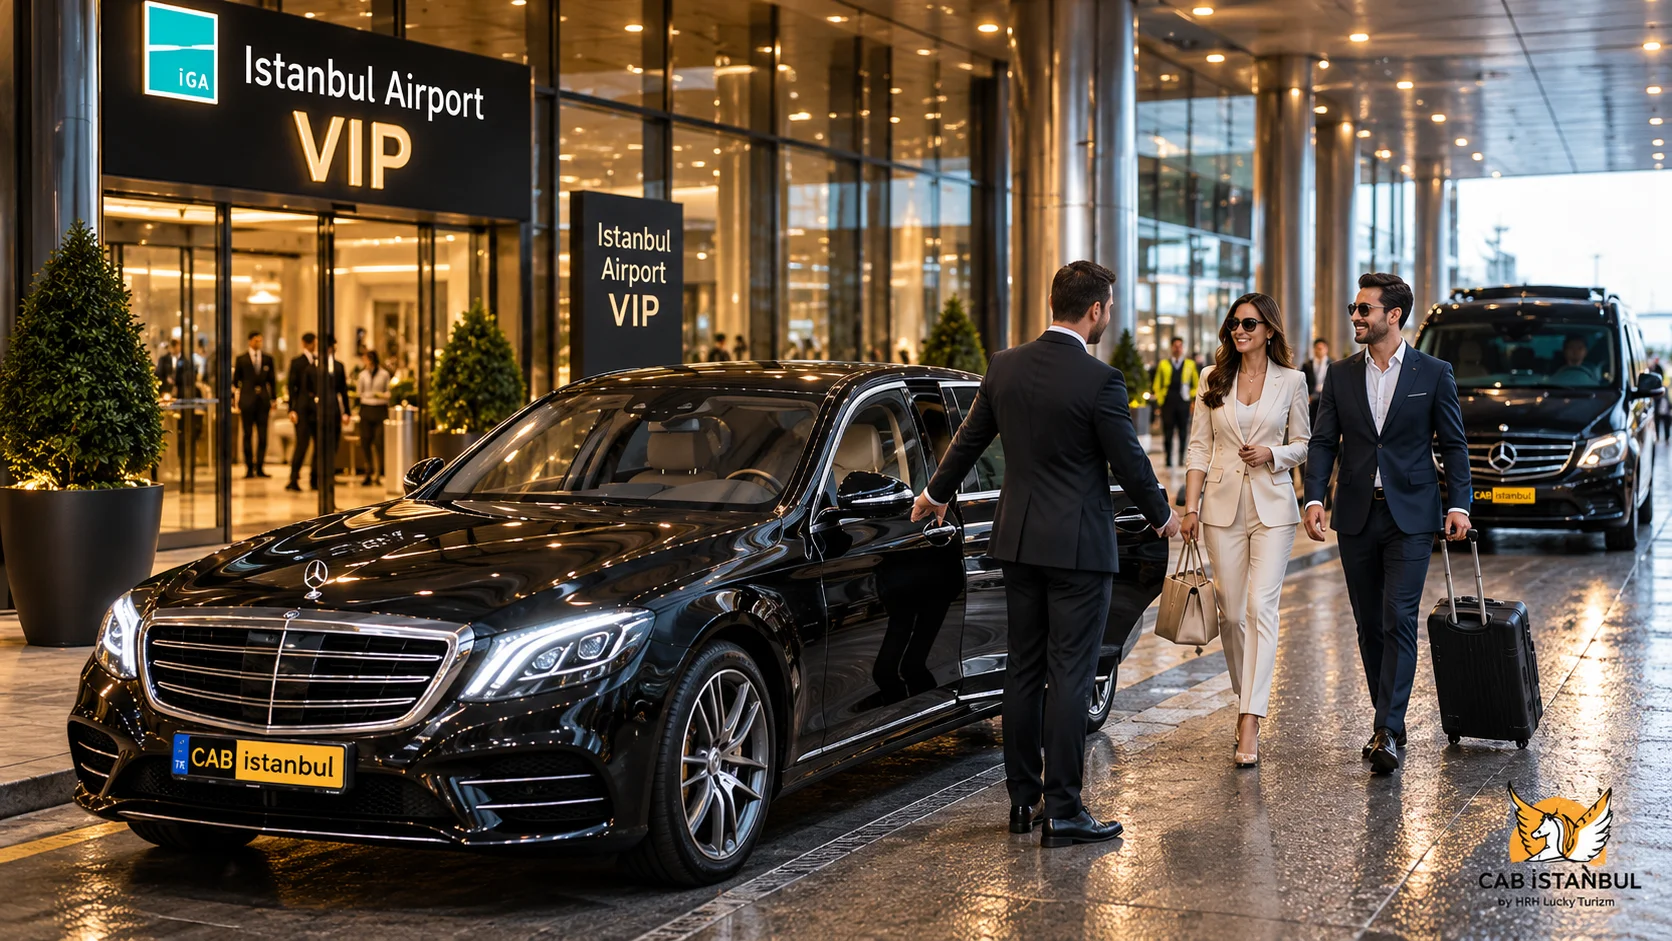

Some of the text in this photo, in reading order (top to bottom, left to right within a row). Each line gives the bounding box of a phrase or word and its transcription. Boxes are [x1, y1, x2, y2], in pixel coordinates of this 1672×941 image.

[245, 45, 485, 122] Istanbul Airport
[292, 110, 412, 190] VIP
[598, 222, 671, 252] Istanbul
[601, 256, 667, 288] Airport
[608, 293, 660, 327] VIP
[1474, 491, 1492, 500] CAB
[191, 747, 334, 778] CAB istanbul
